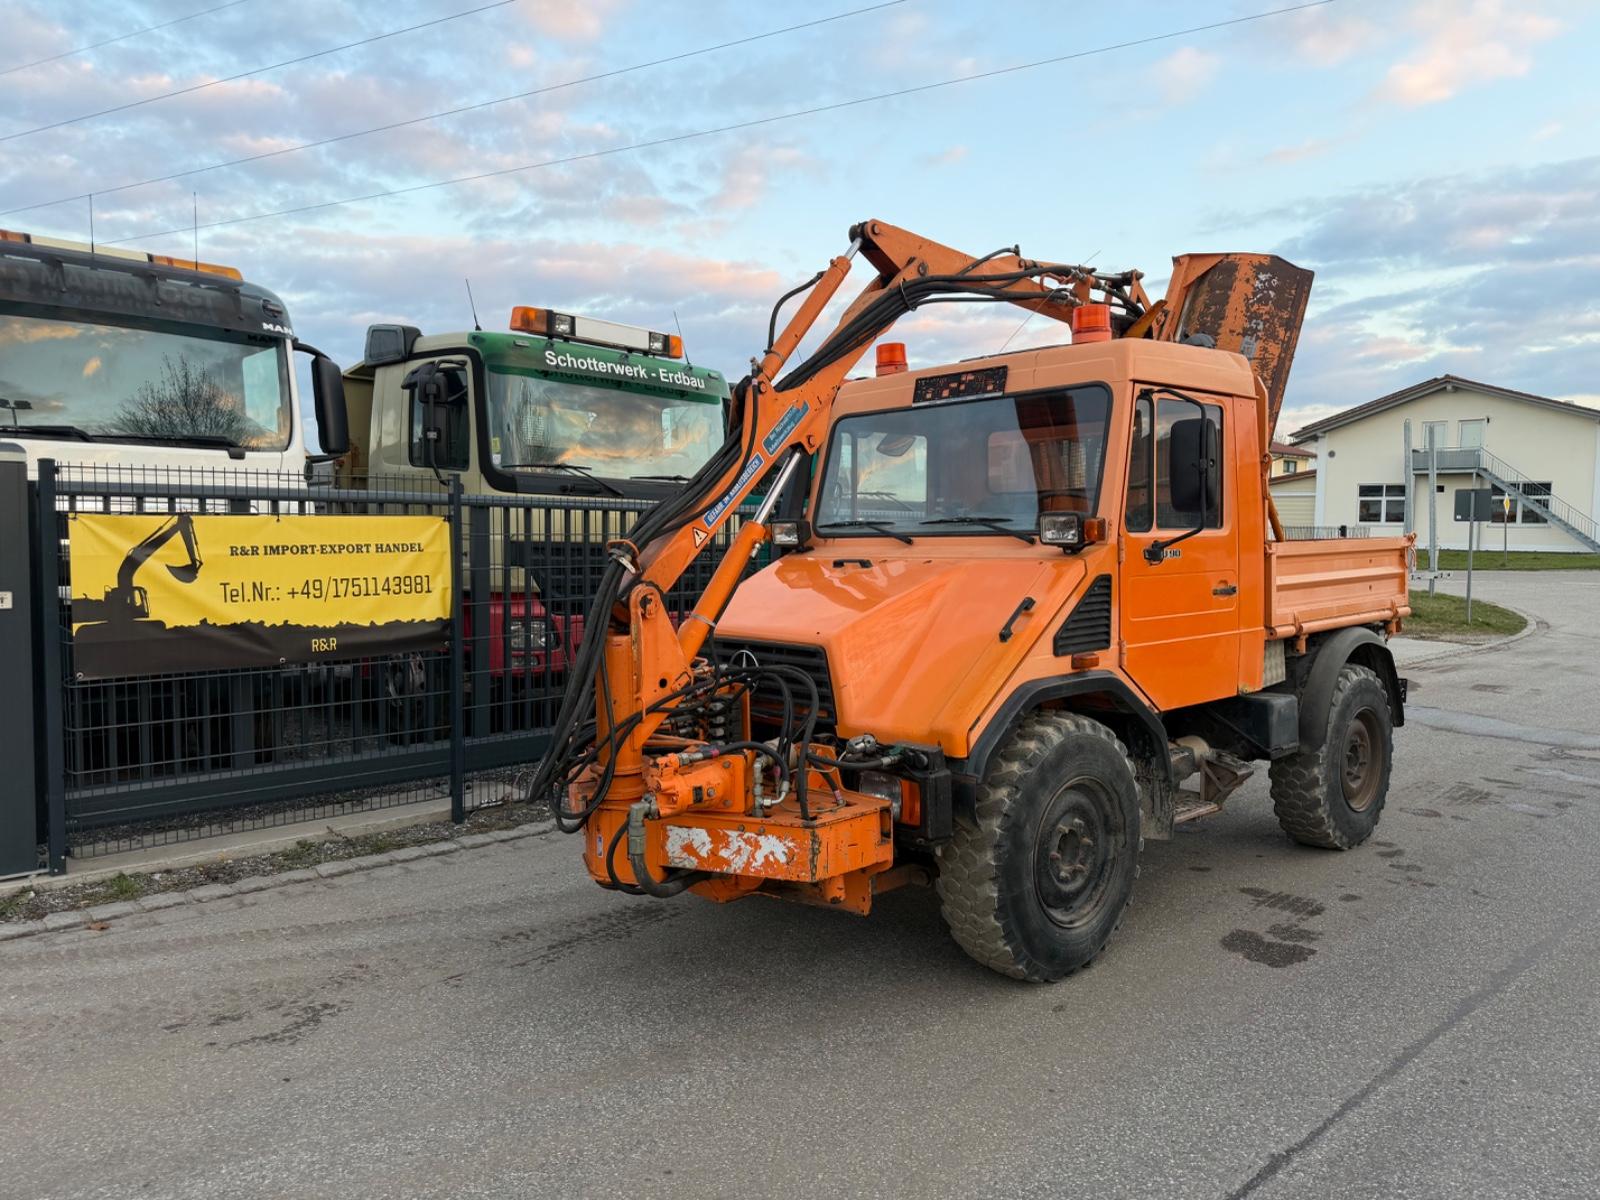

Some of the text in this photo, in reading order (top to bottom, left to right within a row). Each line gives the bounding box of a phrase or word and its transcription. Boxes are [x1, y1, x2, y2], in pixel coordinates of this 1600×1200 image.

[262, 322, 293, 336] MAN
[544, 350, 648, 379] Schotterwerk
[658, 367, 706, 389] Erdbau
[229, 542, 425, 557] R&R IMPORT-EXPORT HANDEL
[219, 575, 433, 603] Tel.Nr.: +49/1751143981
[311, 637, 337, 653] R&R
